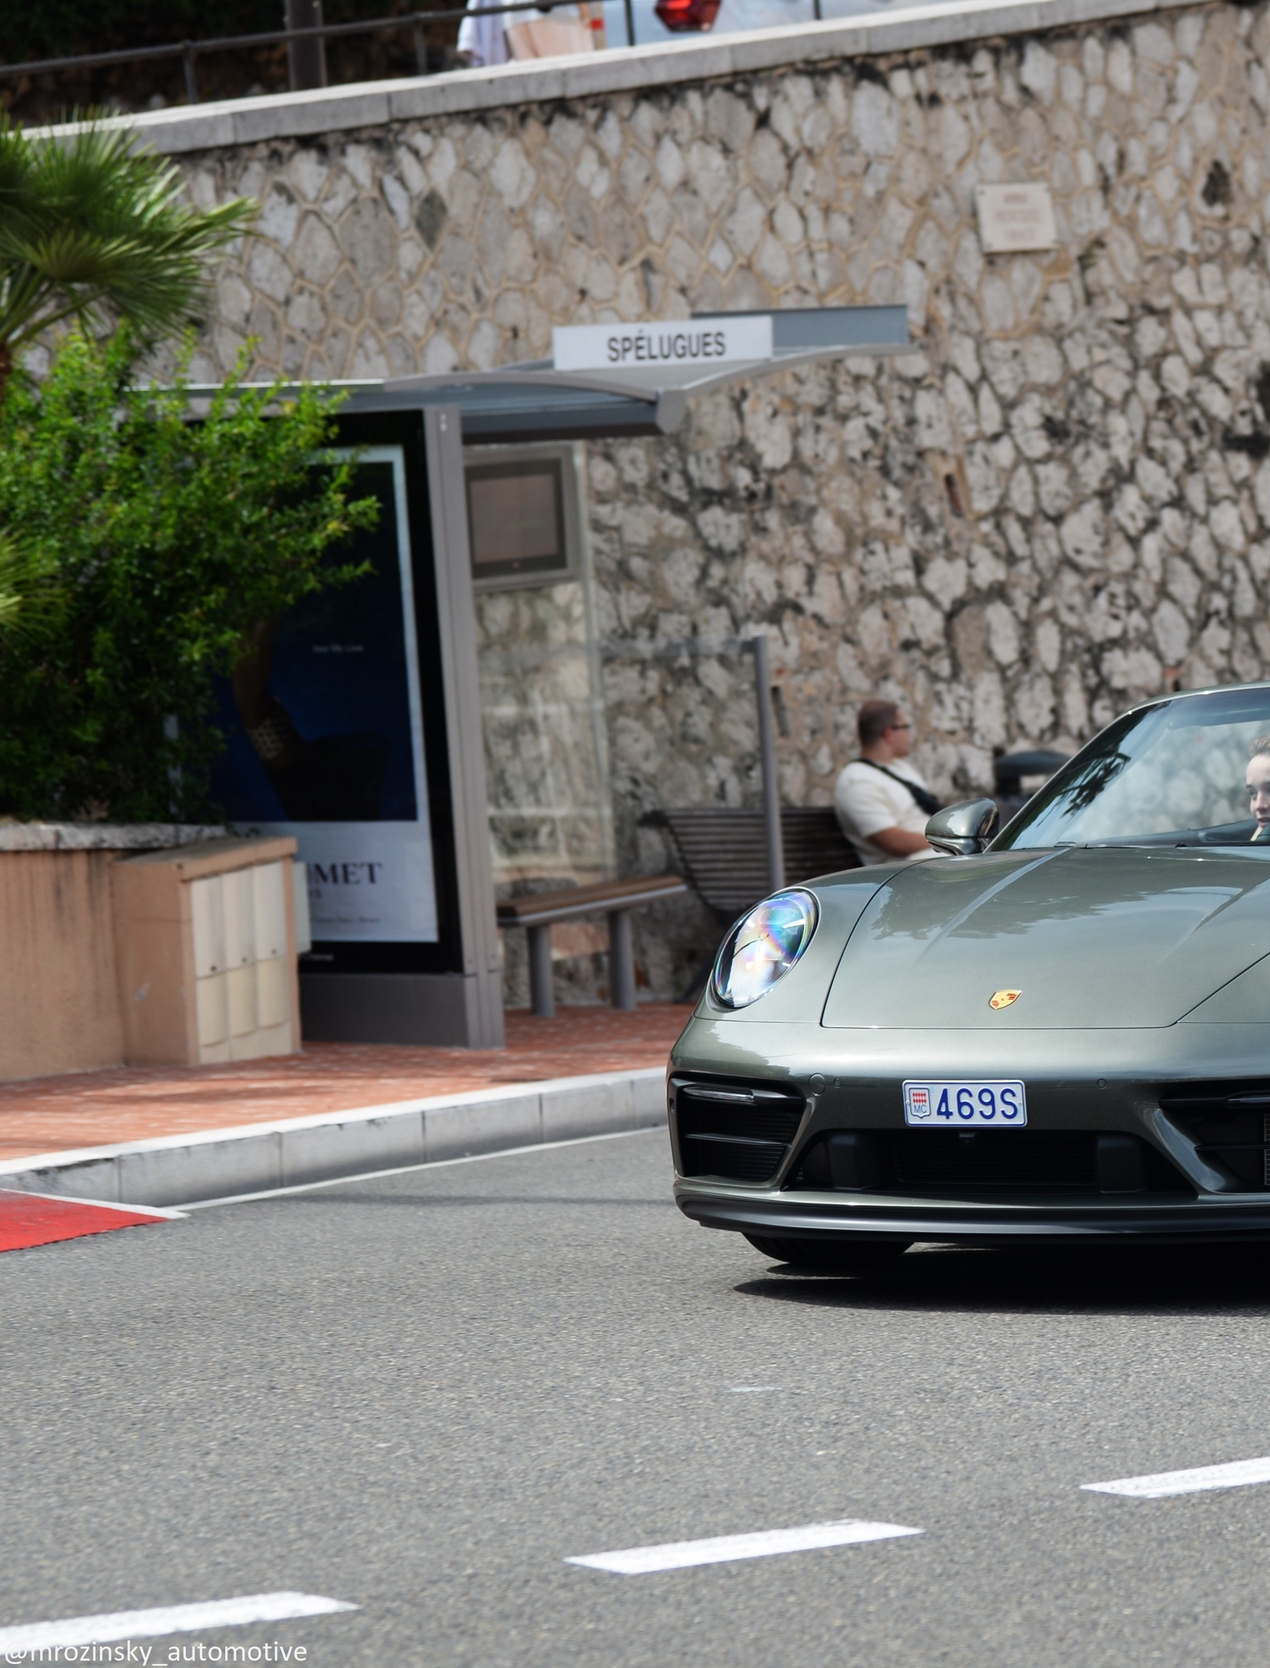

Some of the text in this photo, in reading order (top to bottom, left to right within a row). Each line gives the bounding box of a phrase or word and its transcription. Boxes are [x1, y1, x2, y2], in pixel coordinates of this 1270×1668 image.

[607, 329, 726, 362] SPÉLUGUES
[914, 1104, 927, 1114] MC
[936, 1088, 1018, 1119] 469S
